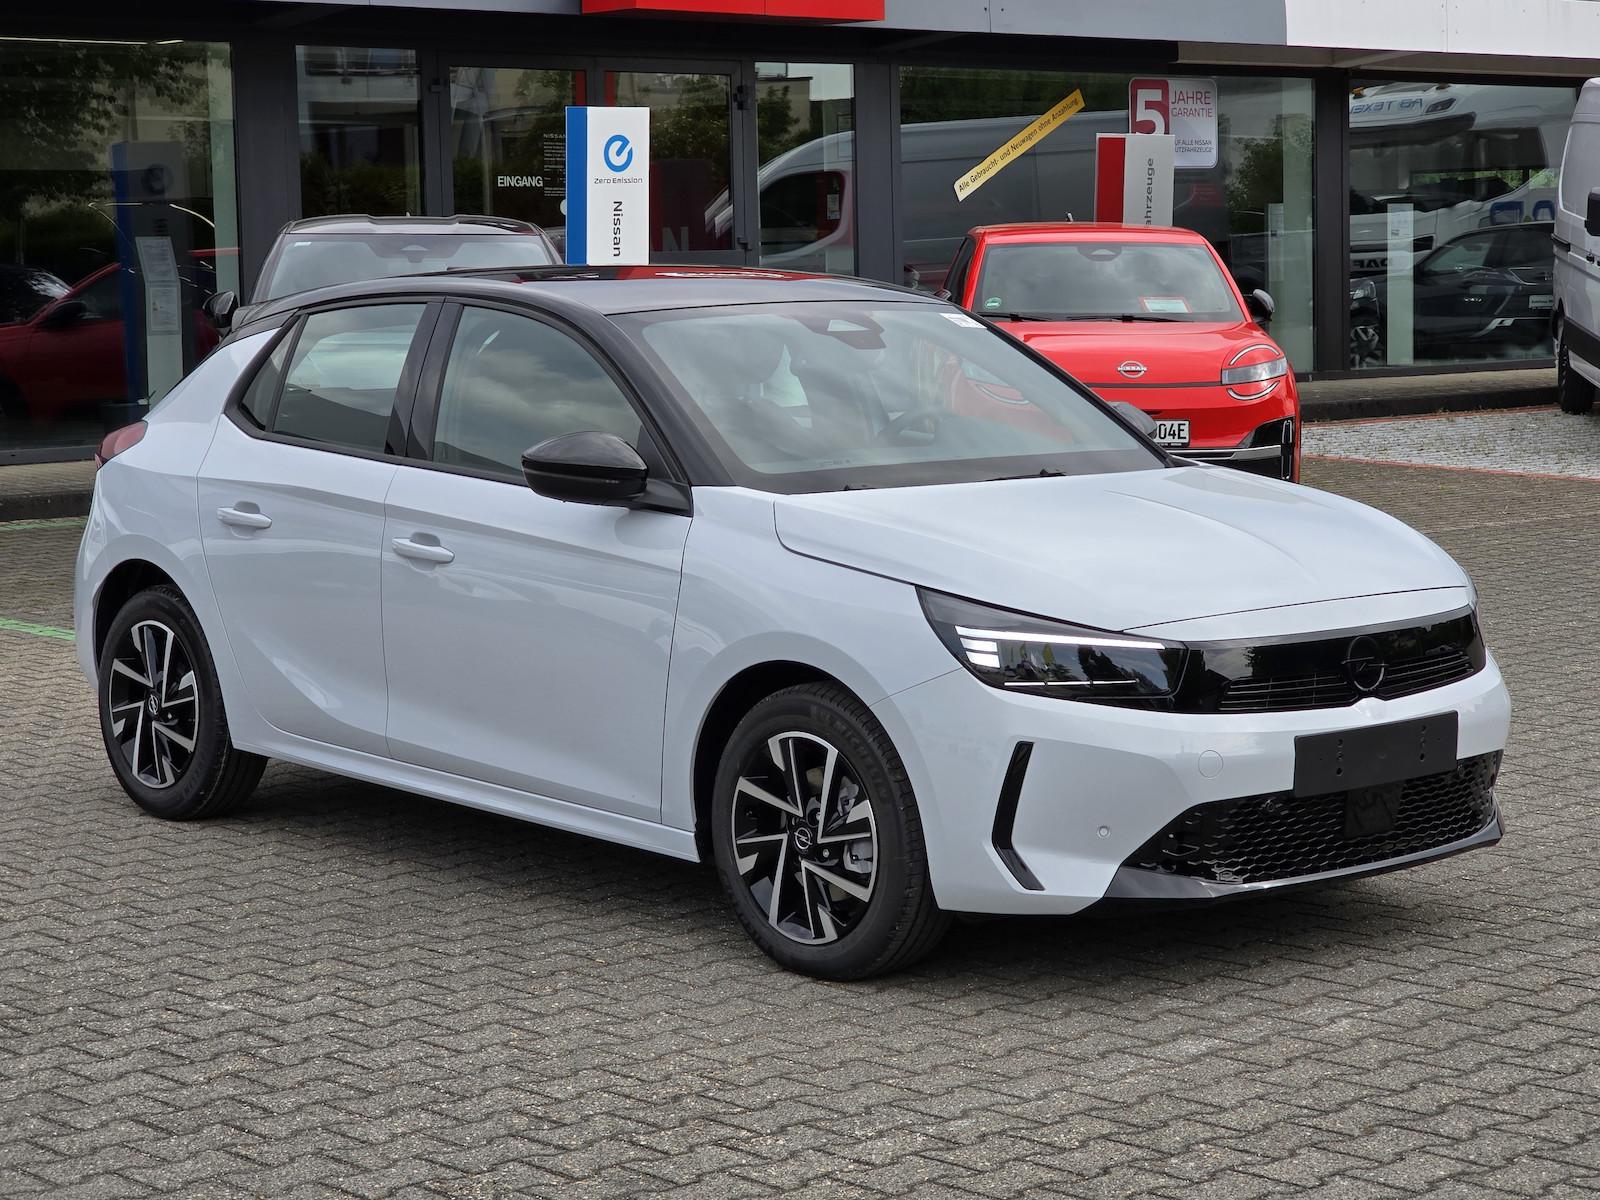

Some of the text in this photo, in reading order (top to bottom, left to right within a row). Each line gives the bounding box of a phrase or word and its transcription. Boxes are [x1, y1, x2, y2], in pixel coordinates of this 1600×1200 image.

[1136, 88, 1212, 135] 5 JAHRE
[1171, 107, 1213, 118] GARANTIE
[958, 181, 970, 193] Alle
[970, 158, 1000, 183] Gebraucht-
[999, 149, 1011, 161] und
[1010, 129, 1038, 153] Neuwagen
[1038, 119, 1051, 132] ohne
[497, 175, 544, 188] EINGANG
[594, 177, 612, 185] Zero
[1144, 157, 1156, 226] ahrzeuge
[613, 200, 624, 257] Nissan
[1158, 423, 1187, 440] 04E
